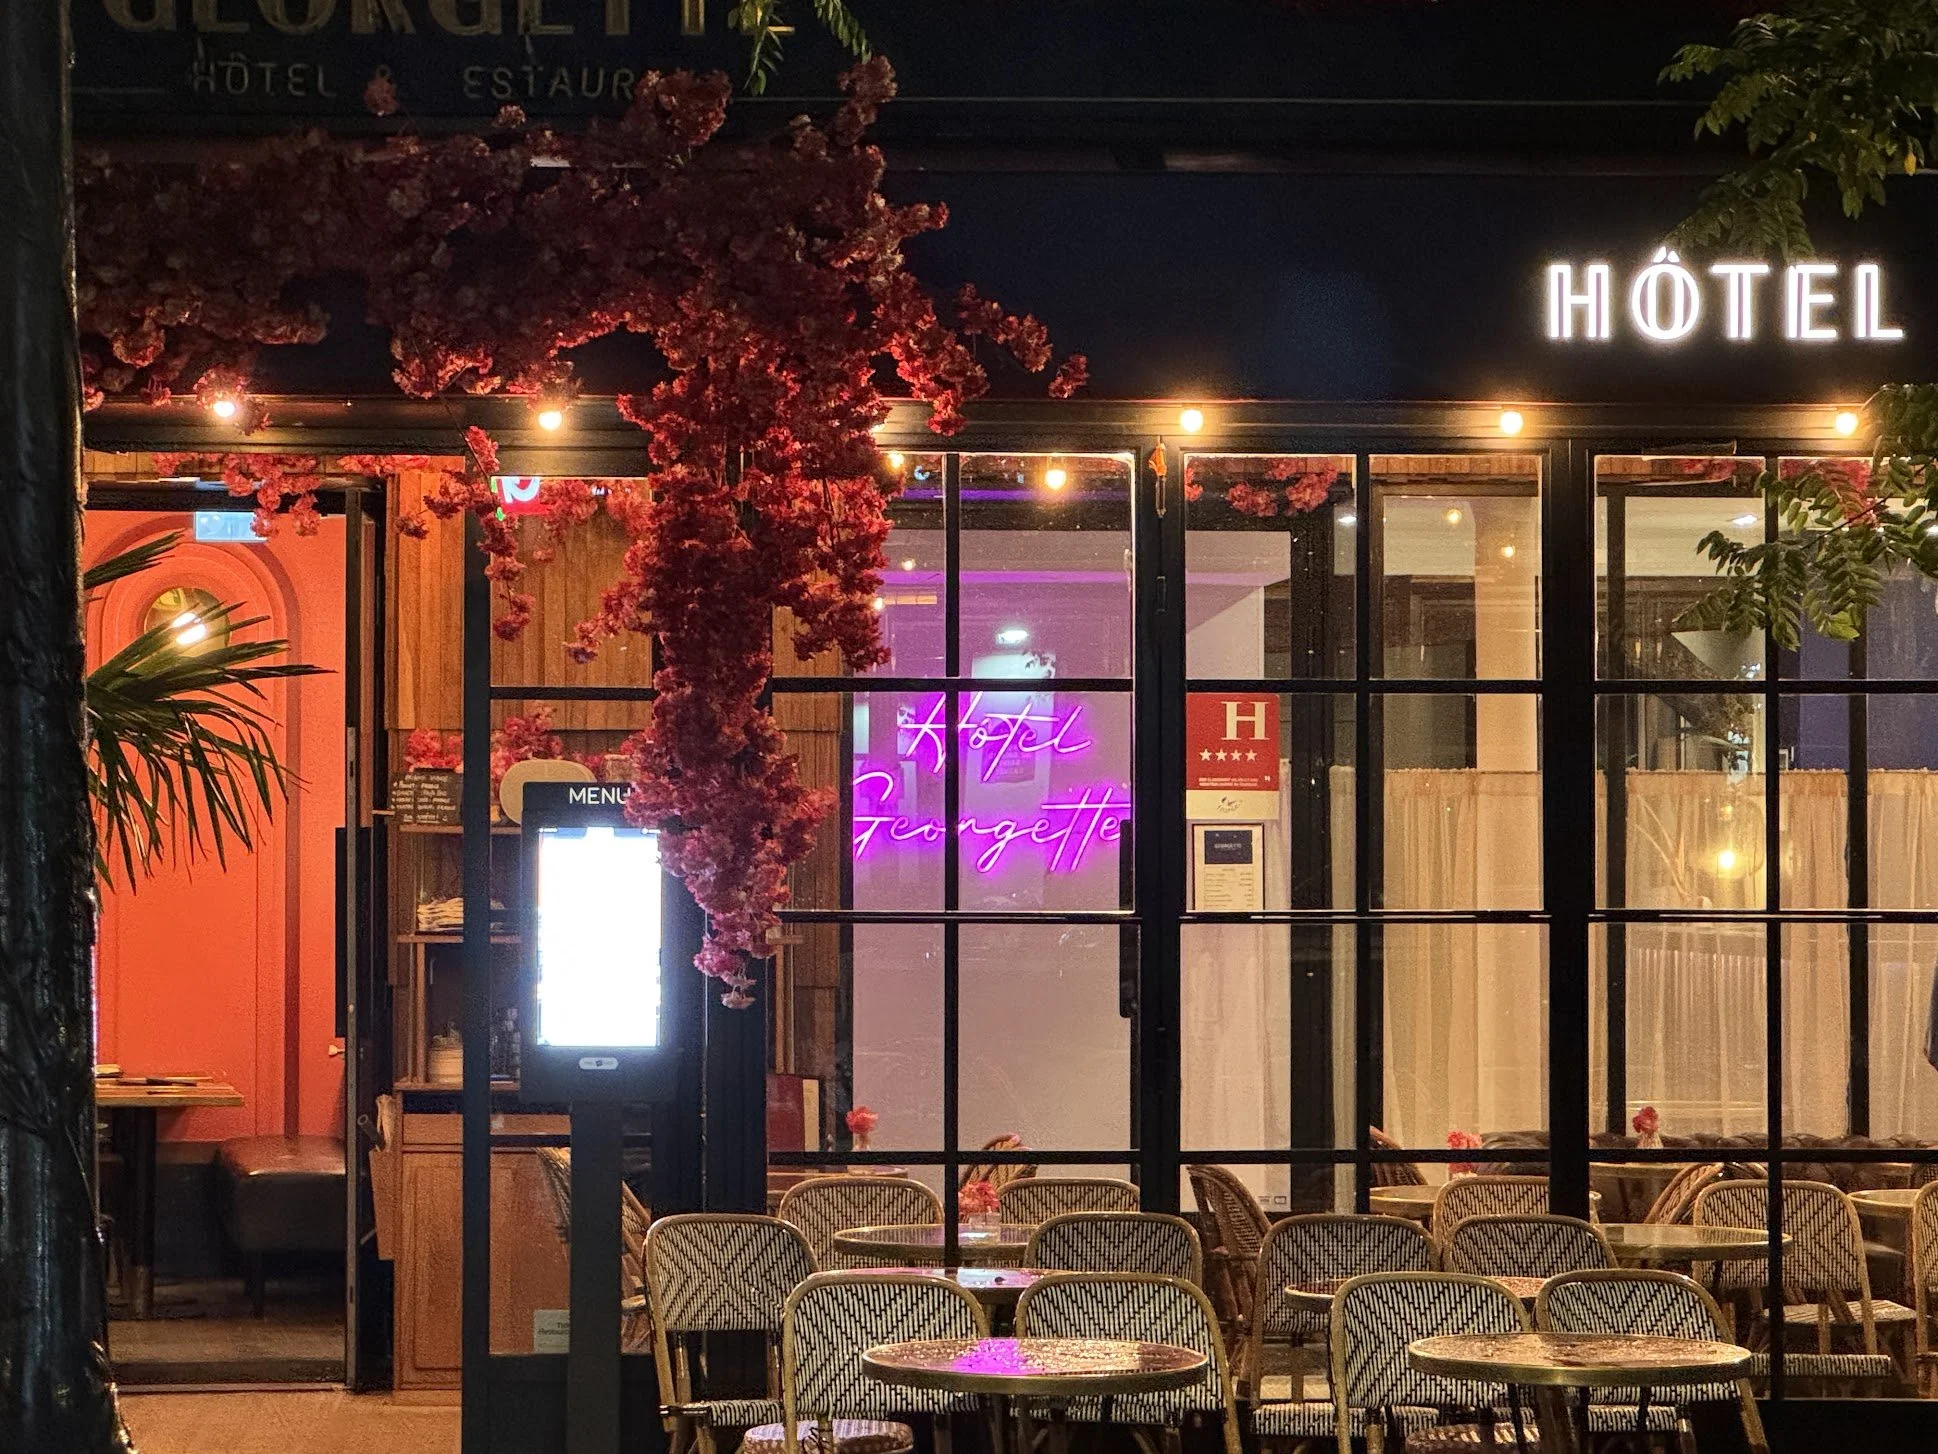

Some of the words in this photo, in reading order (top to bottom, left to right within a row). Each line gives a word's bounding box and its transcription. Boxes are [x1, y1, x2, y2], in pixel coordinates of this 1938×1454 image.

[191, 50, 338, 98] HÔTEL
[1548, 247, 1905, 341] HÔTEL
[1221, 701, 1270, 740] H
[569, 787, 631, 805] MENU
